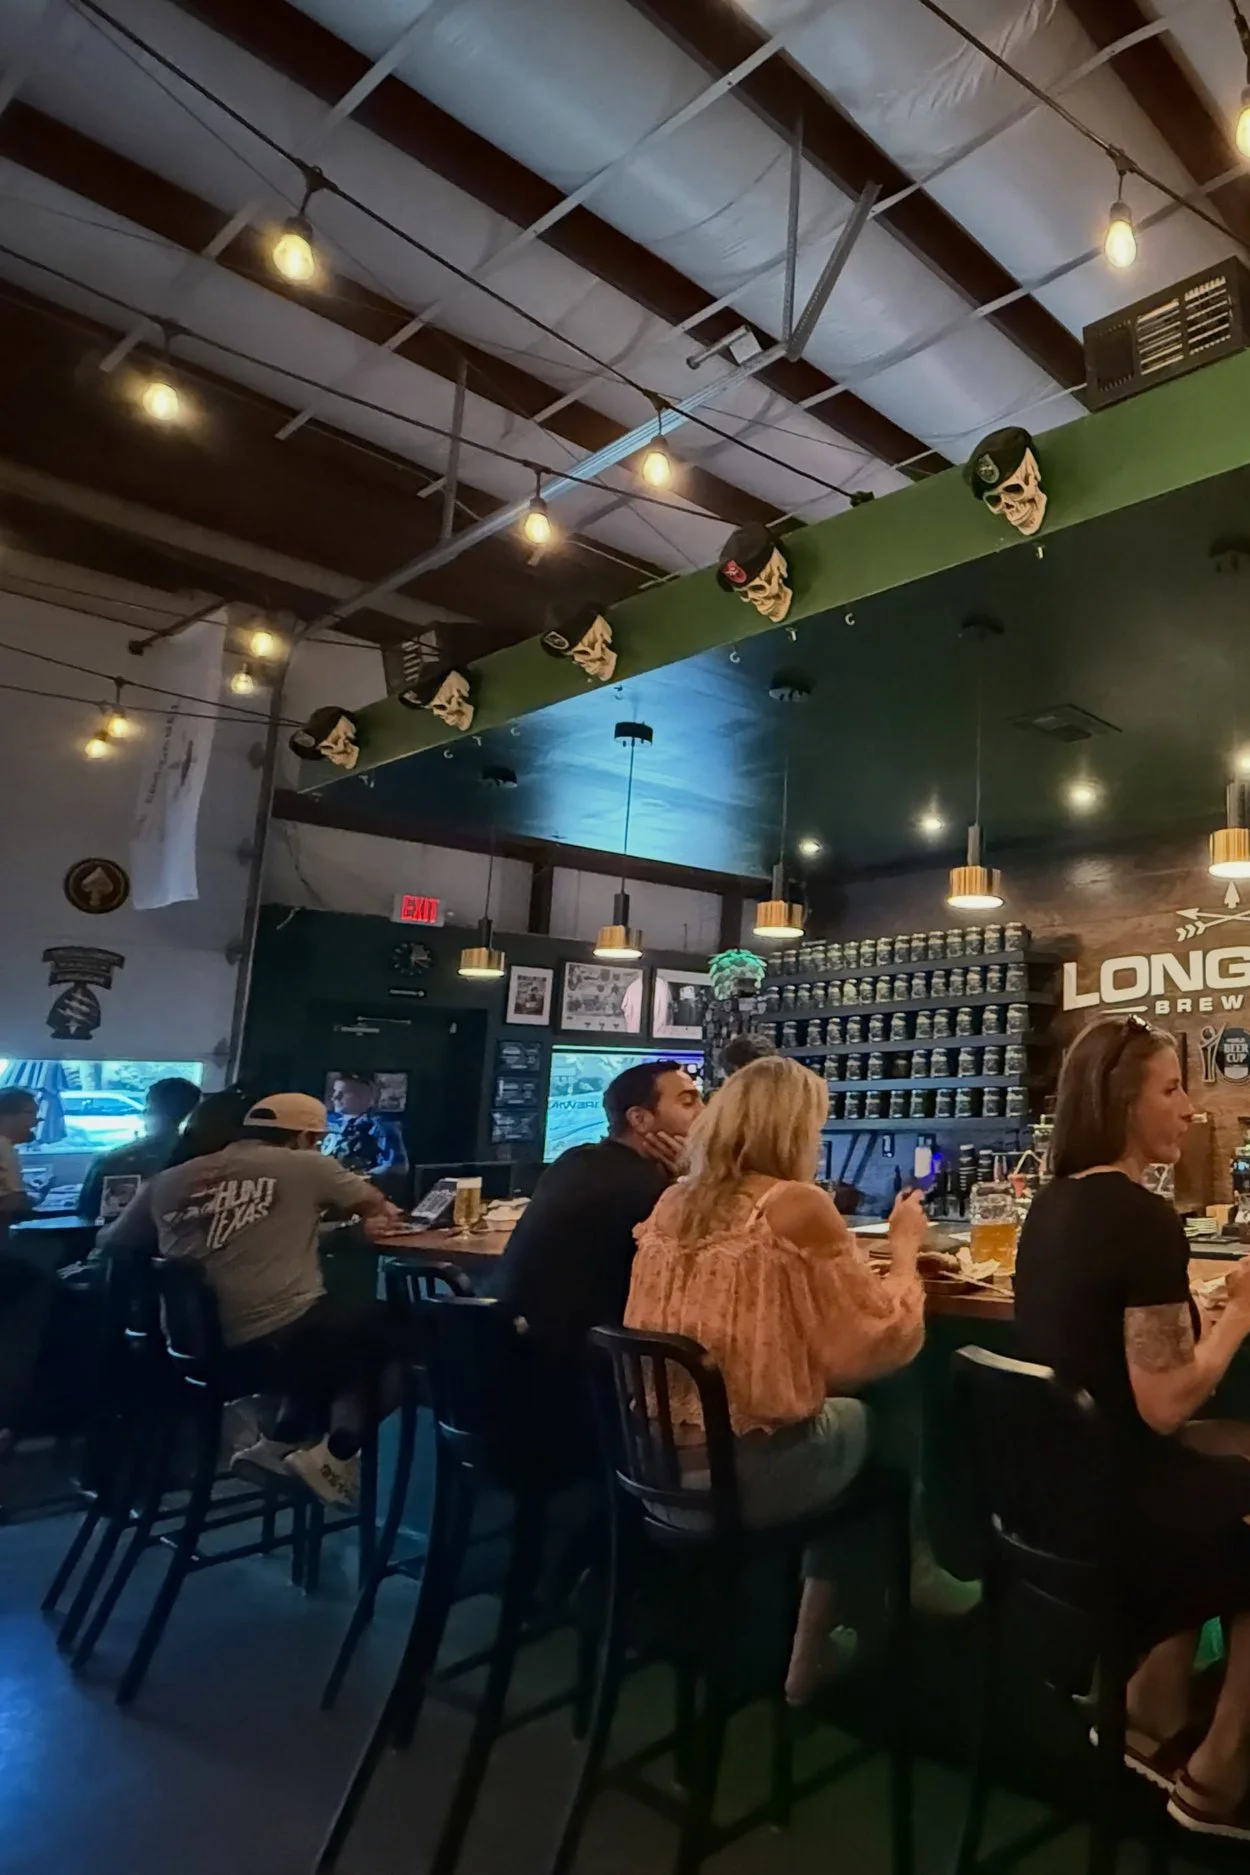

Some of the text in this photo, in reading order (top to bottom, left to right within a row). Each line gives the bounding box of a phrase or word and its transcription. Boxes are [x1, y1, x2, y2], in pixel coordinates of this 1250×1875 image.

[401, 893, 440, 924] EXIT
[1223, 1043, 1249, 1054] BEER
[1226, 1053, 1247, 1063] CUP
[215, 1177, 277, 1212] HUNT
[206, 1202, 269, 1249] TEXAS
